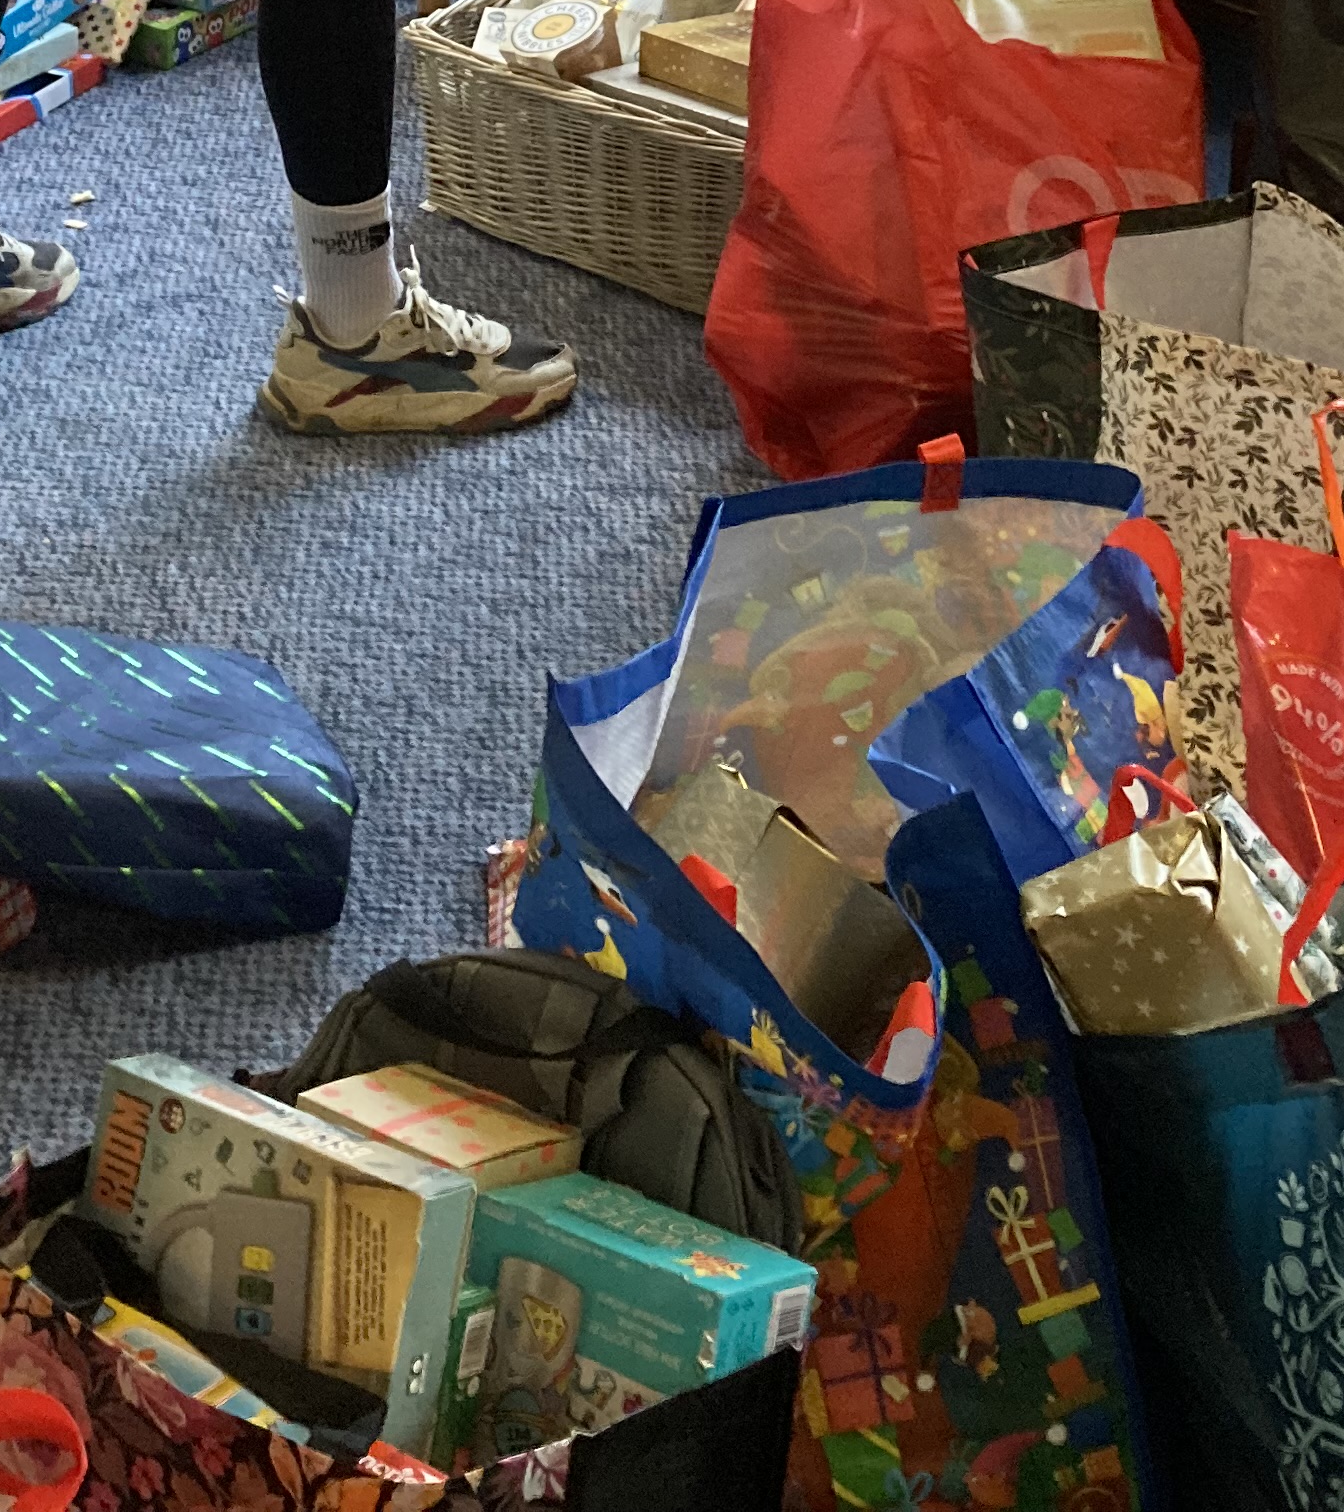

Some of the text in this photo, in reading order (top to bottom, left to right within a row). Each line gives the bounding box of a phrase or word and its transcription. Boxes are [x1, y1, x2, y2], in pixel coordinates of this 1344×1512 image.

[544, 4, 592, 23] CHEESE
[517, 30, 564, 50] NIBBLES
[1270, 683, 1344, 756] 94%
[90, 1089, 154, 1216] ROOM
